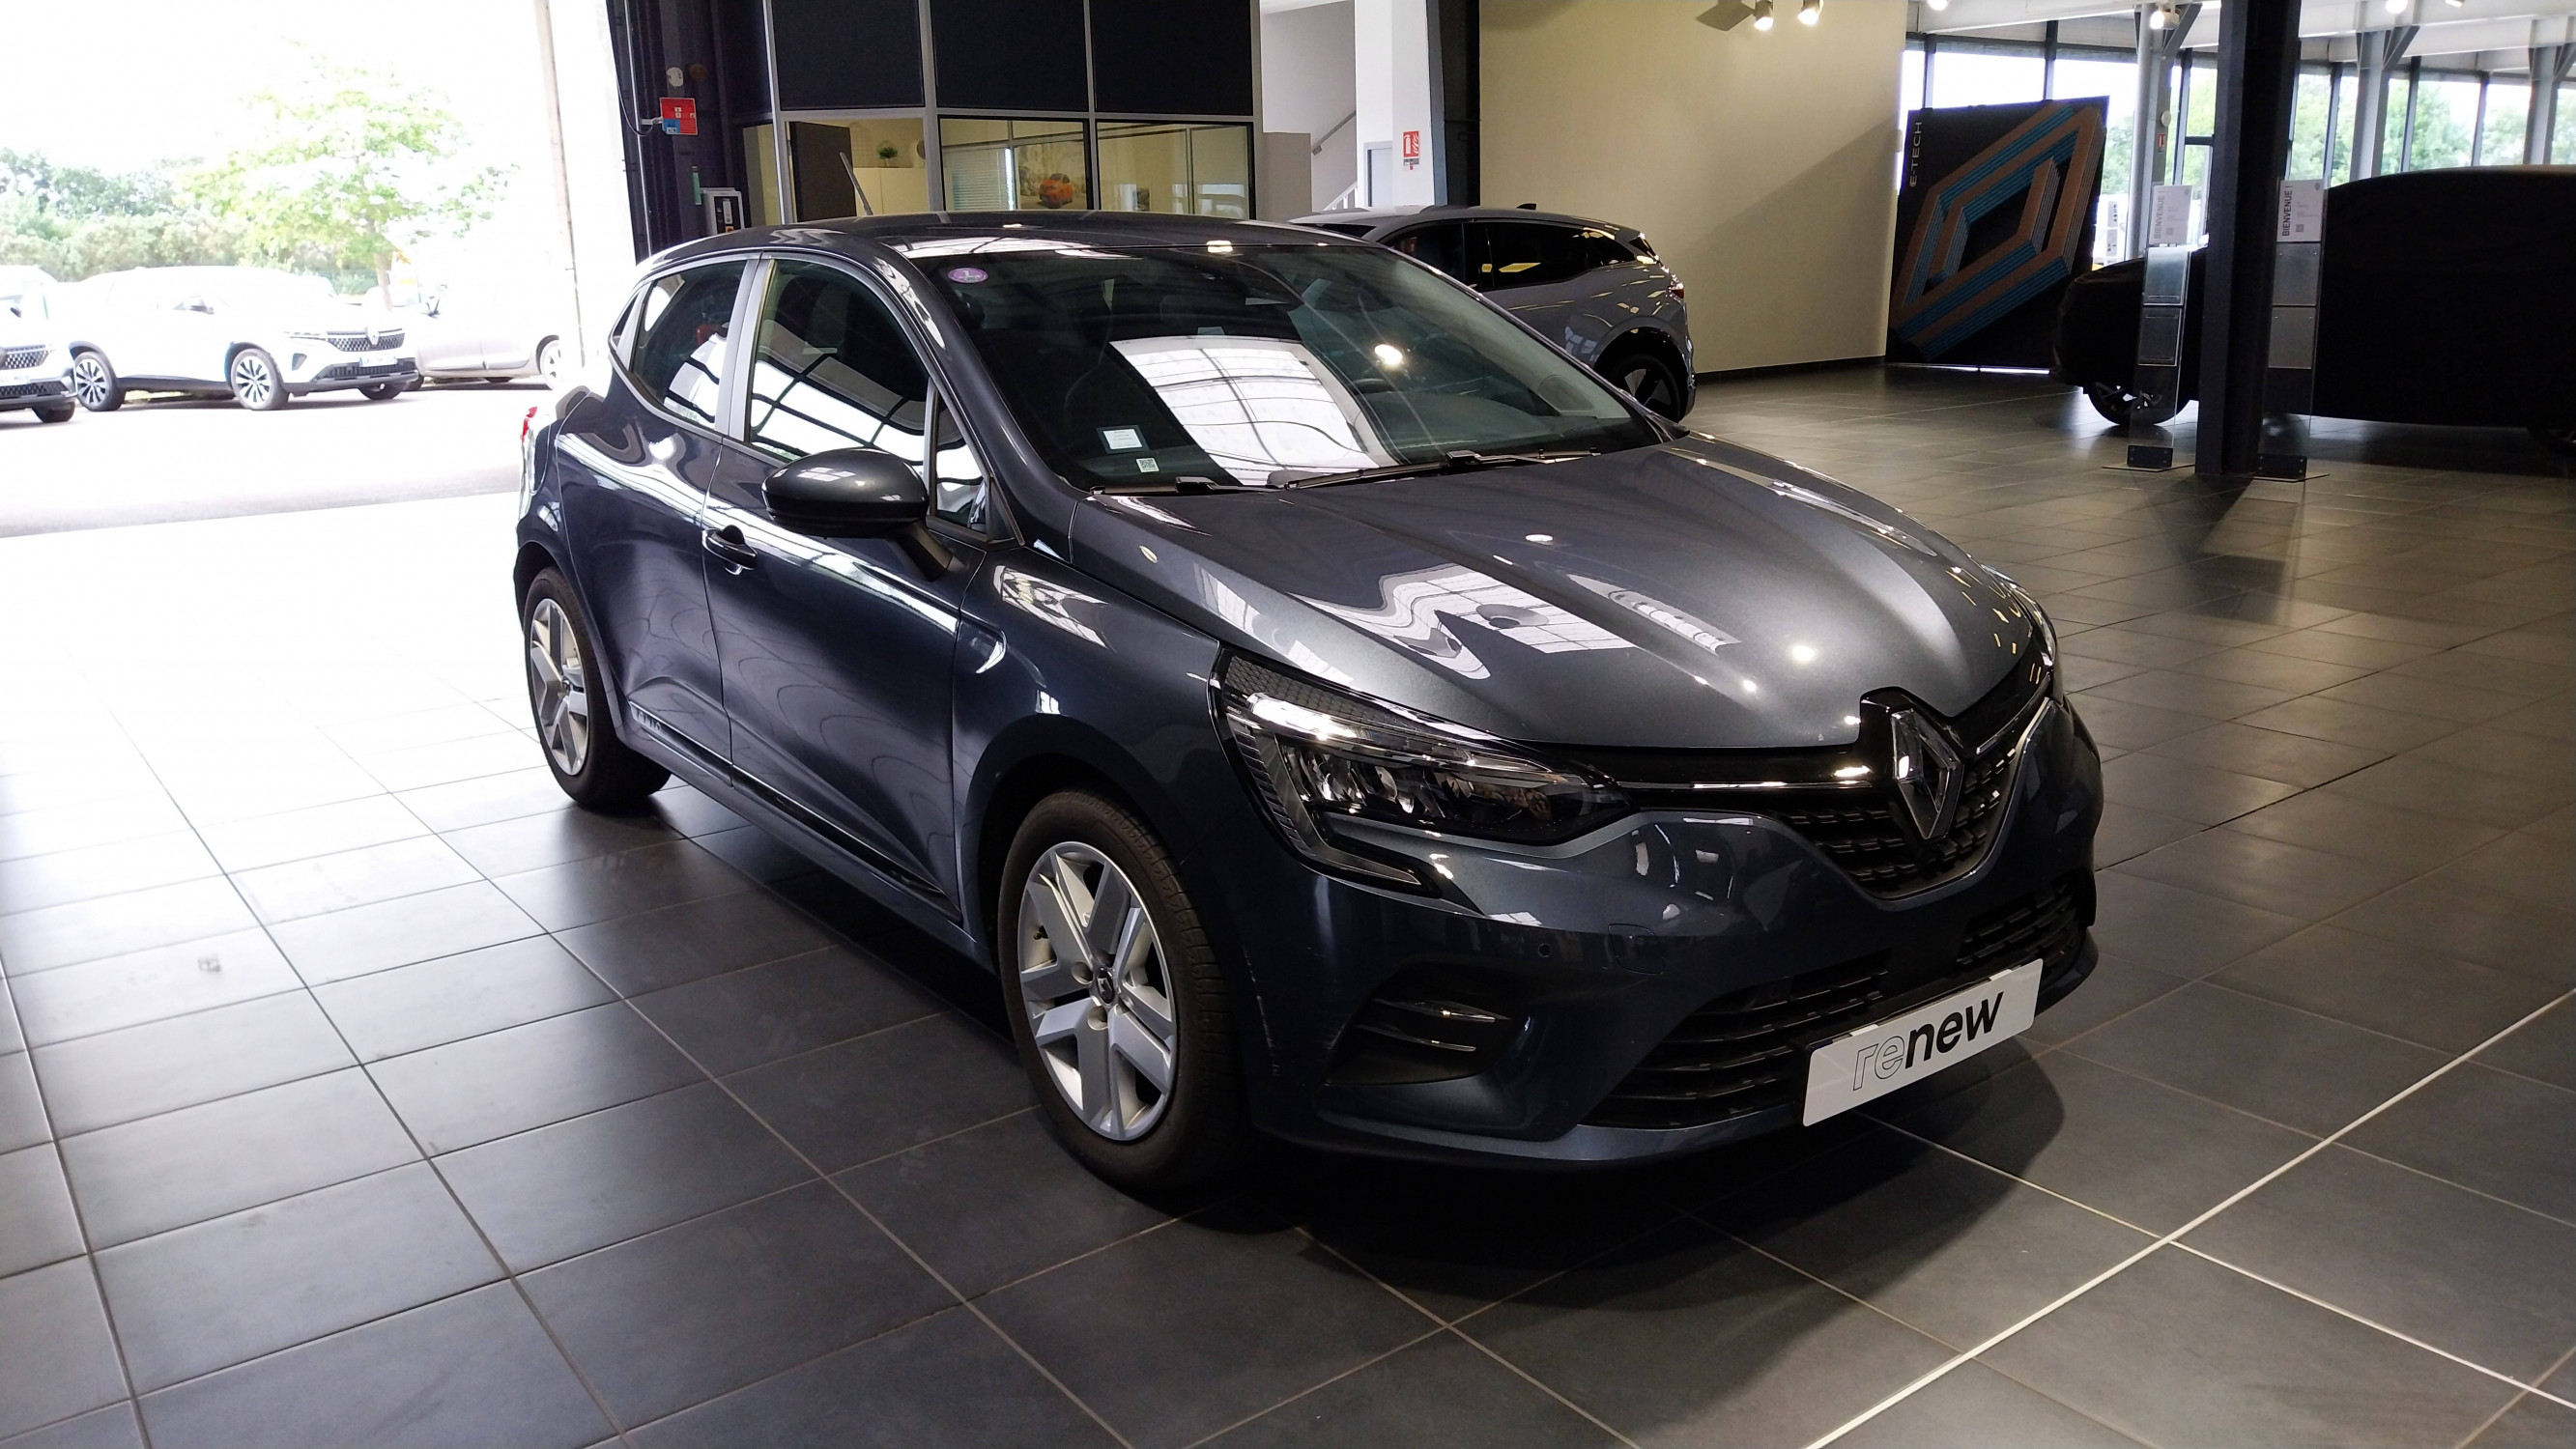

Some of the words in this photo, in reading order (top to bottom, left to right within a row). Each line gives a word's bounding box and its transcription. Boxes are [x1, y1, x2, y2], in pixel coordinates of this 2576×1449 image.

[1909, 122, 1922, 187] E-TECH
[2282, 190, 2293, 237] BIENVENUE
[1853, 991, 2004, 1092] renew
